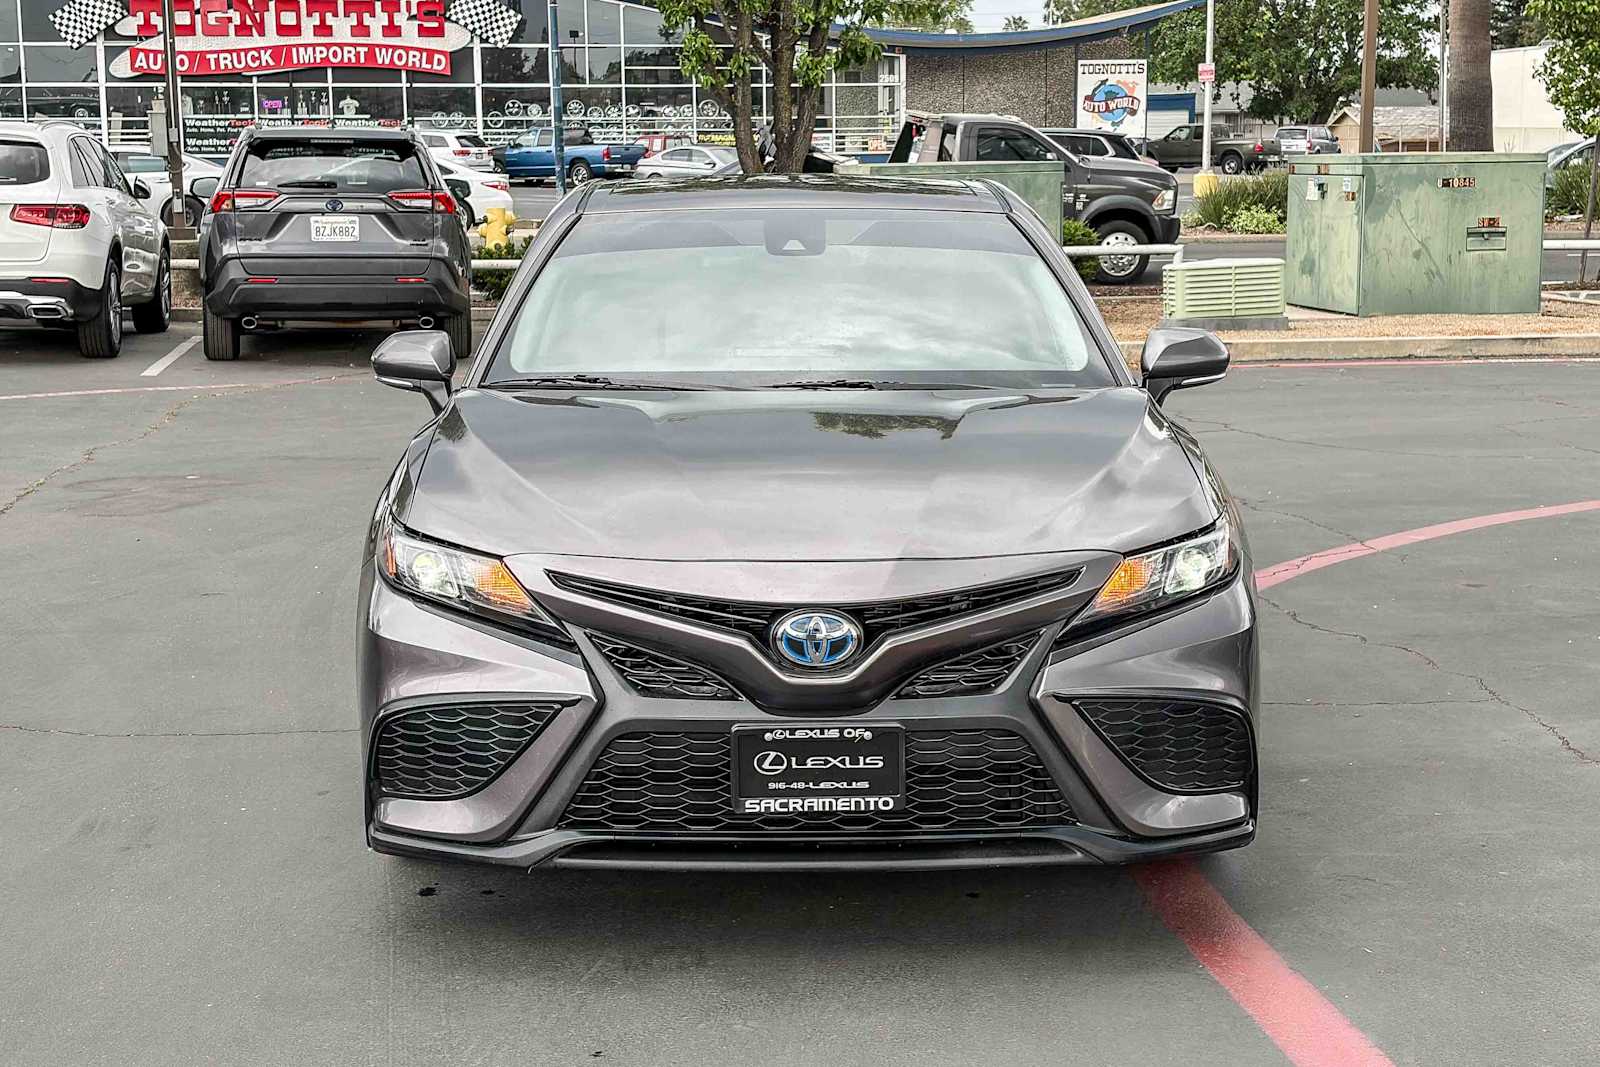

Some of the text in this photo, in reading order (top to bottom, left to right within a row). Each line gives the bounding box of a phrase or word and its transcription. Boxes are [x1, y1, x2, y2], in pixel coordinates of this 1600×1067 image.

[129, 0, 445, 37] TOGNOTTI'S
[134, 51, 189, 72] AUO
[206, 47, 275, 71] TRUCK
[292, 46, 368, 64] IMPORT
[374, 50, 446, 71] WORLD
[1080, 62, 1145, 75] TOGNOTTI'S
[1083, 95, 1139, 113] AUTO WORLD
[785, 728, 866, 739] LEXUS OF
[790, 756, 884, 769] LEXUS
[768, 781, 870, 789] 916-48-LEXUS
[744, 797, 894, 812] SACRAMENTO
